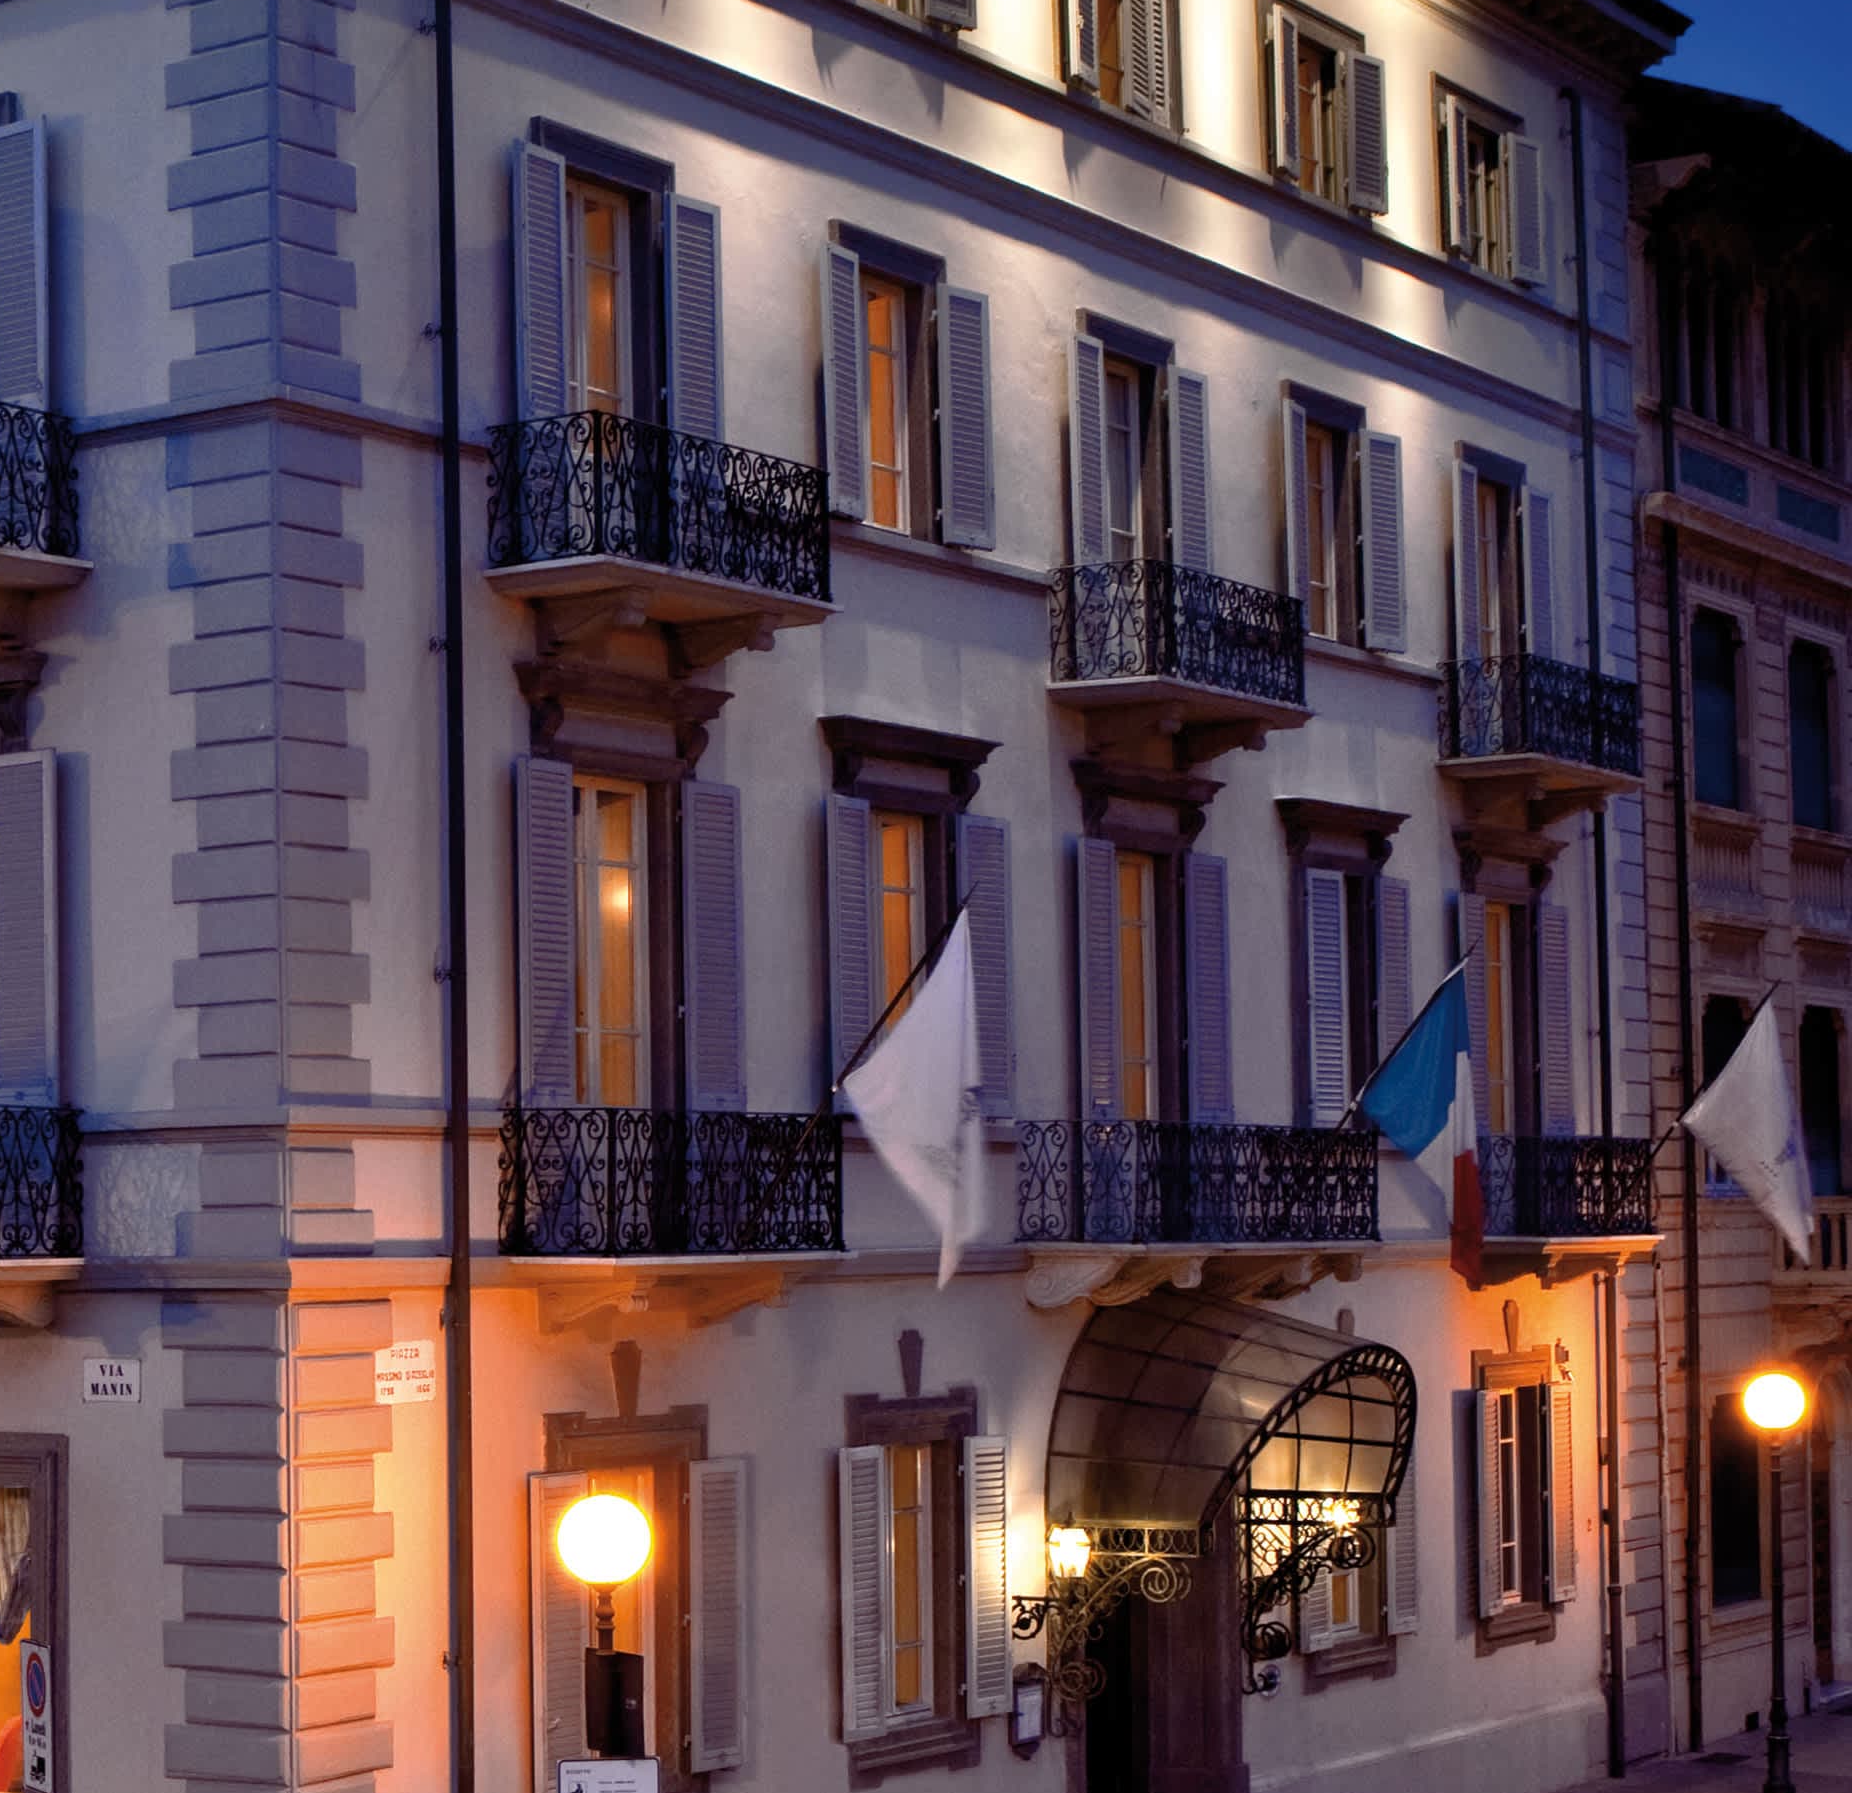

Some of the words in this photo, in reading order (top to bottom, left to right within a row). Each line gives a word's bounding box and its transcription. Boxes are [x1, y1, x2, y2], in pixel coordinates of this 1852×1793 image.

[390, 1348, 419, 1359] PIAZZA
[99, 1364, 124, 1377] VIA
[90, 1383, 133, 1396] MANIN
